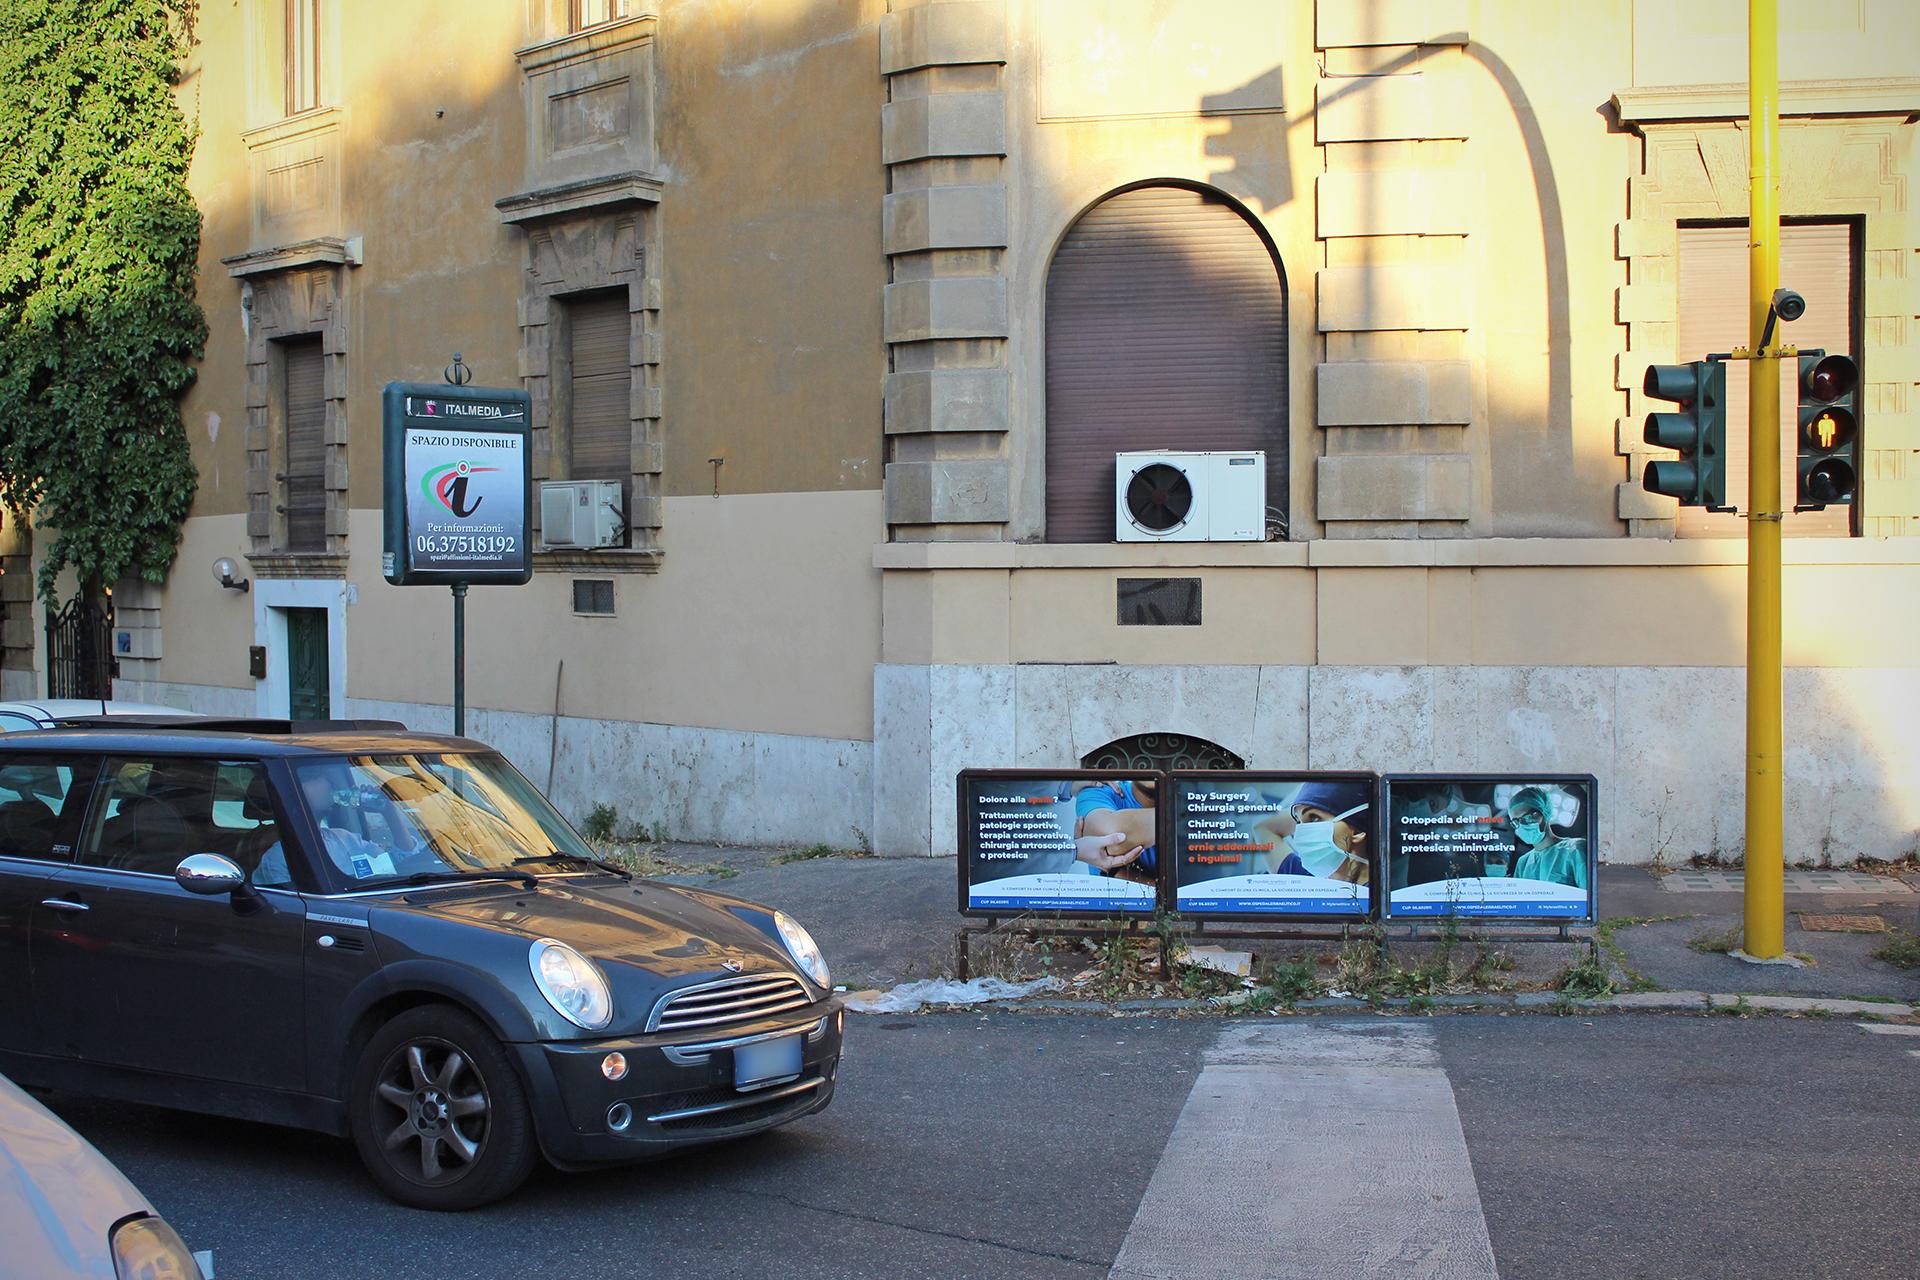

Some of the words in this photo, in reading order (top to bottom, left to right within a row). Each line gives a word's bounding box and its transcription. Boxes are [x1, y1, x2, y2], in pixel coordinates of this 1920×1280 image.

[445, 404, 502, 416] ITALMEDIA
[412, 436, 450, 446] SPAZIO
[452, 438, 516, 448] DISPONIBILE
[428, 523, 441, 532] Per
[444, 523, 504, 533] informazioni:
[417, 536, 516, 552] 06.37518192
[1188, 792, 1207, 801] Day
[1210, 792, 1250, 801] Surgery
[1188, 803, 1234, 812] Chirurgia
[1238, 804, 1282, 812] generale
[980, 812, 1034, 820] Trattamento
[1401, 816, 1453, 824] Ortopedia
[980, 822, 1020, 830] patologie
[1023, 822, 1062, 830] sportive,
[1188, 819, 1235, 830] Chirurgia
[980, 832, 1010, 840] terapia
[1013, 832, 1072, 840] conservativa,
[1188, 831, 1249, 840] mininvasiva
[1402, 832, 1440, 842] Terapie
[1452, 832, 1499, 841] chirurgia
[980, 842, 1020, 850] chirurgia
[1022, 842, 1076, 851] artroscopica
[1402, 844, 1450, 854] protesica
[1452, 843, 1516, 852] mininvasiva
[988, 852, 1028, 860] protesica
[1198, 854, 1242, 864] inguinali
